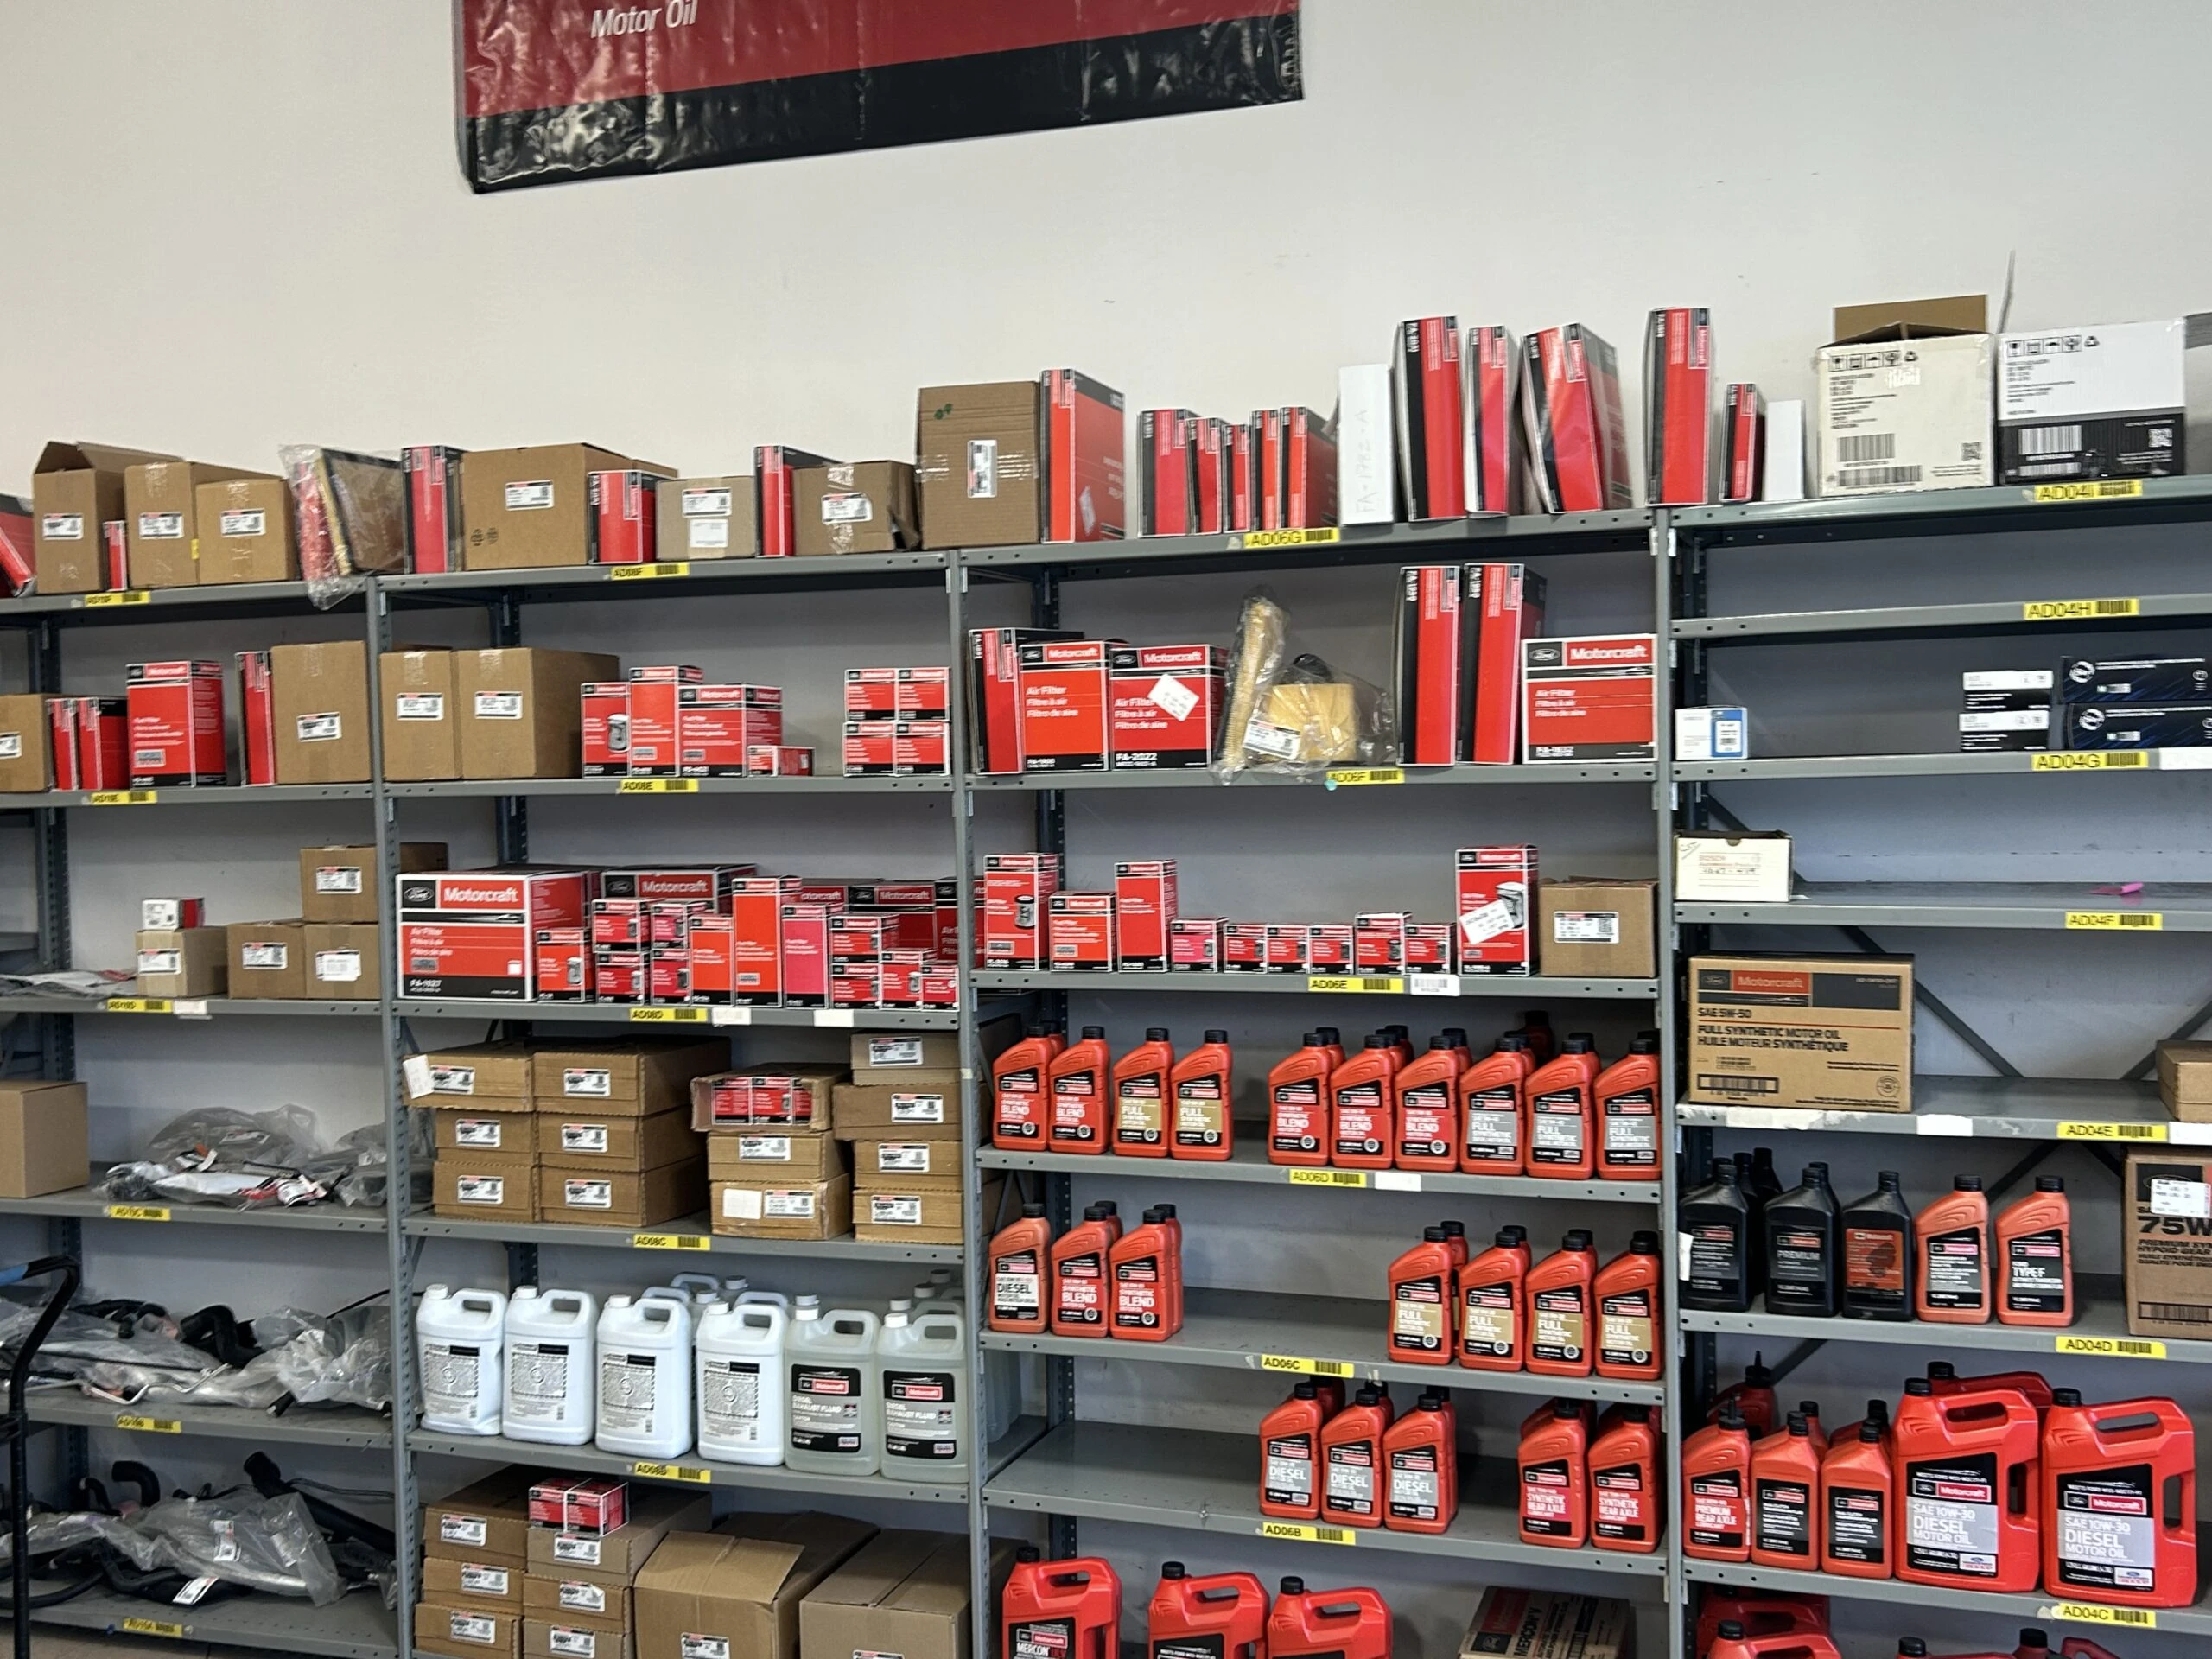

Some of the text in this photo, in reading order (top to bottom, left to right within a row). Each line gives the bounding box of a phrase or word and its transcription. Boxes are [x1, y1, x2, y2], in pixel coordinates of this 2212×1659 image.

[590, 0, 698, 38] Motor Oil
[1252, 531, 1303, 546] AD06G
[2028, 603, 2092, 620] AD04H
[1049, 648, 1097, 658] Motorcraft
[1144, 652, 1202, 663] Motorcraft
[1571, 645, 1648, 660] Motorcraft
[2036, 754, 2101, 770] AD04G
[642, 880, 707, 893] Motorcraft
[444, 887, 518, 903] Motorcraft
[801, 891, 842, 900] otorcraft
[1312, 980, 1348, 990] AD06E
[1738, 976, 1804, 989] Motorcraft
[1698, 1008, 1718, 1018] SAE
[1698, 1025, 1840, 1039] FULL SYNTHETIC MOTOR OIL
[1698, 1037, 1849, 1052] HUILE MOTEUR SYNTHÉTIQUE
[1001, 1105, 1030, 1116] BLEND
[1056, 1108, 1085, 1118] BLEND
[1277, 1118, 1310, 1128] BLEND
[1339, 1121, 1373, 1132] BLEND
[1406, 1122, 1440, 1134] BLEND
[2067, 1125, 2113, 1138] AD04E
[1293, 1171, 1330, 1184] AD06D
[1777, 1250, 1820, 1261] PREMIUM
[996, 1282, 1033, 1294] DIESEL
[1062, 1292, 1097, 1304] BLEND
[1119, 1295, 1155, 1307] BLEND
[1398, 1309, 1424, 1320] FULL
[1470, 1315, 1495, 1326] FULL
[1538, 1319, 1565, 1331] FULL
[1605, 1324, 1631, 1335] FULL
[2065, 1339, 2113, 1353] AD04D
[1264, 1357, 1300, 1370] AD06C
[1269, 1465, 1307, 1481] DIESEL
[1330, 1472, 1369, 1488] DIESEL
[1394, 1479, 1433, 1494] DIESEL
[1940, 1486, 1986, 1497] Motorcraft
[2093, 1498, 2141, 1510] Motorcraft
[1913, 1503, 1976, 1520] SAE 10W-30
[1265, 1525, 1302, 1538] AD06B
[1913, 1516, 1969, 1535] DIESEL
[2065, 1517, 2131, 1533] SAE 10W-30
[1913, 1529, 1973, 1545] MOTOR OIL
[2065, 1529, 2125, 1548] DIESEL
[2065, 1543, 2128, 1559] MOTOR OIL
[2063, 1606, 2109, 1621] AD04C
[1016, 1642, 1049, 1657] MERCON
